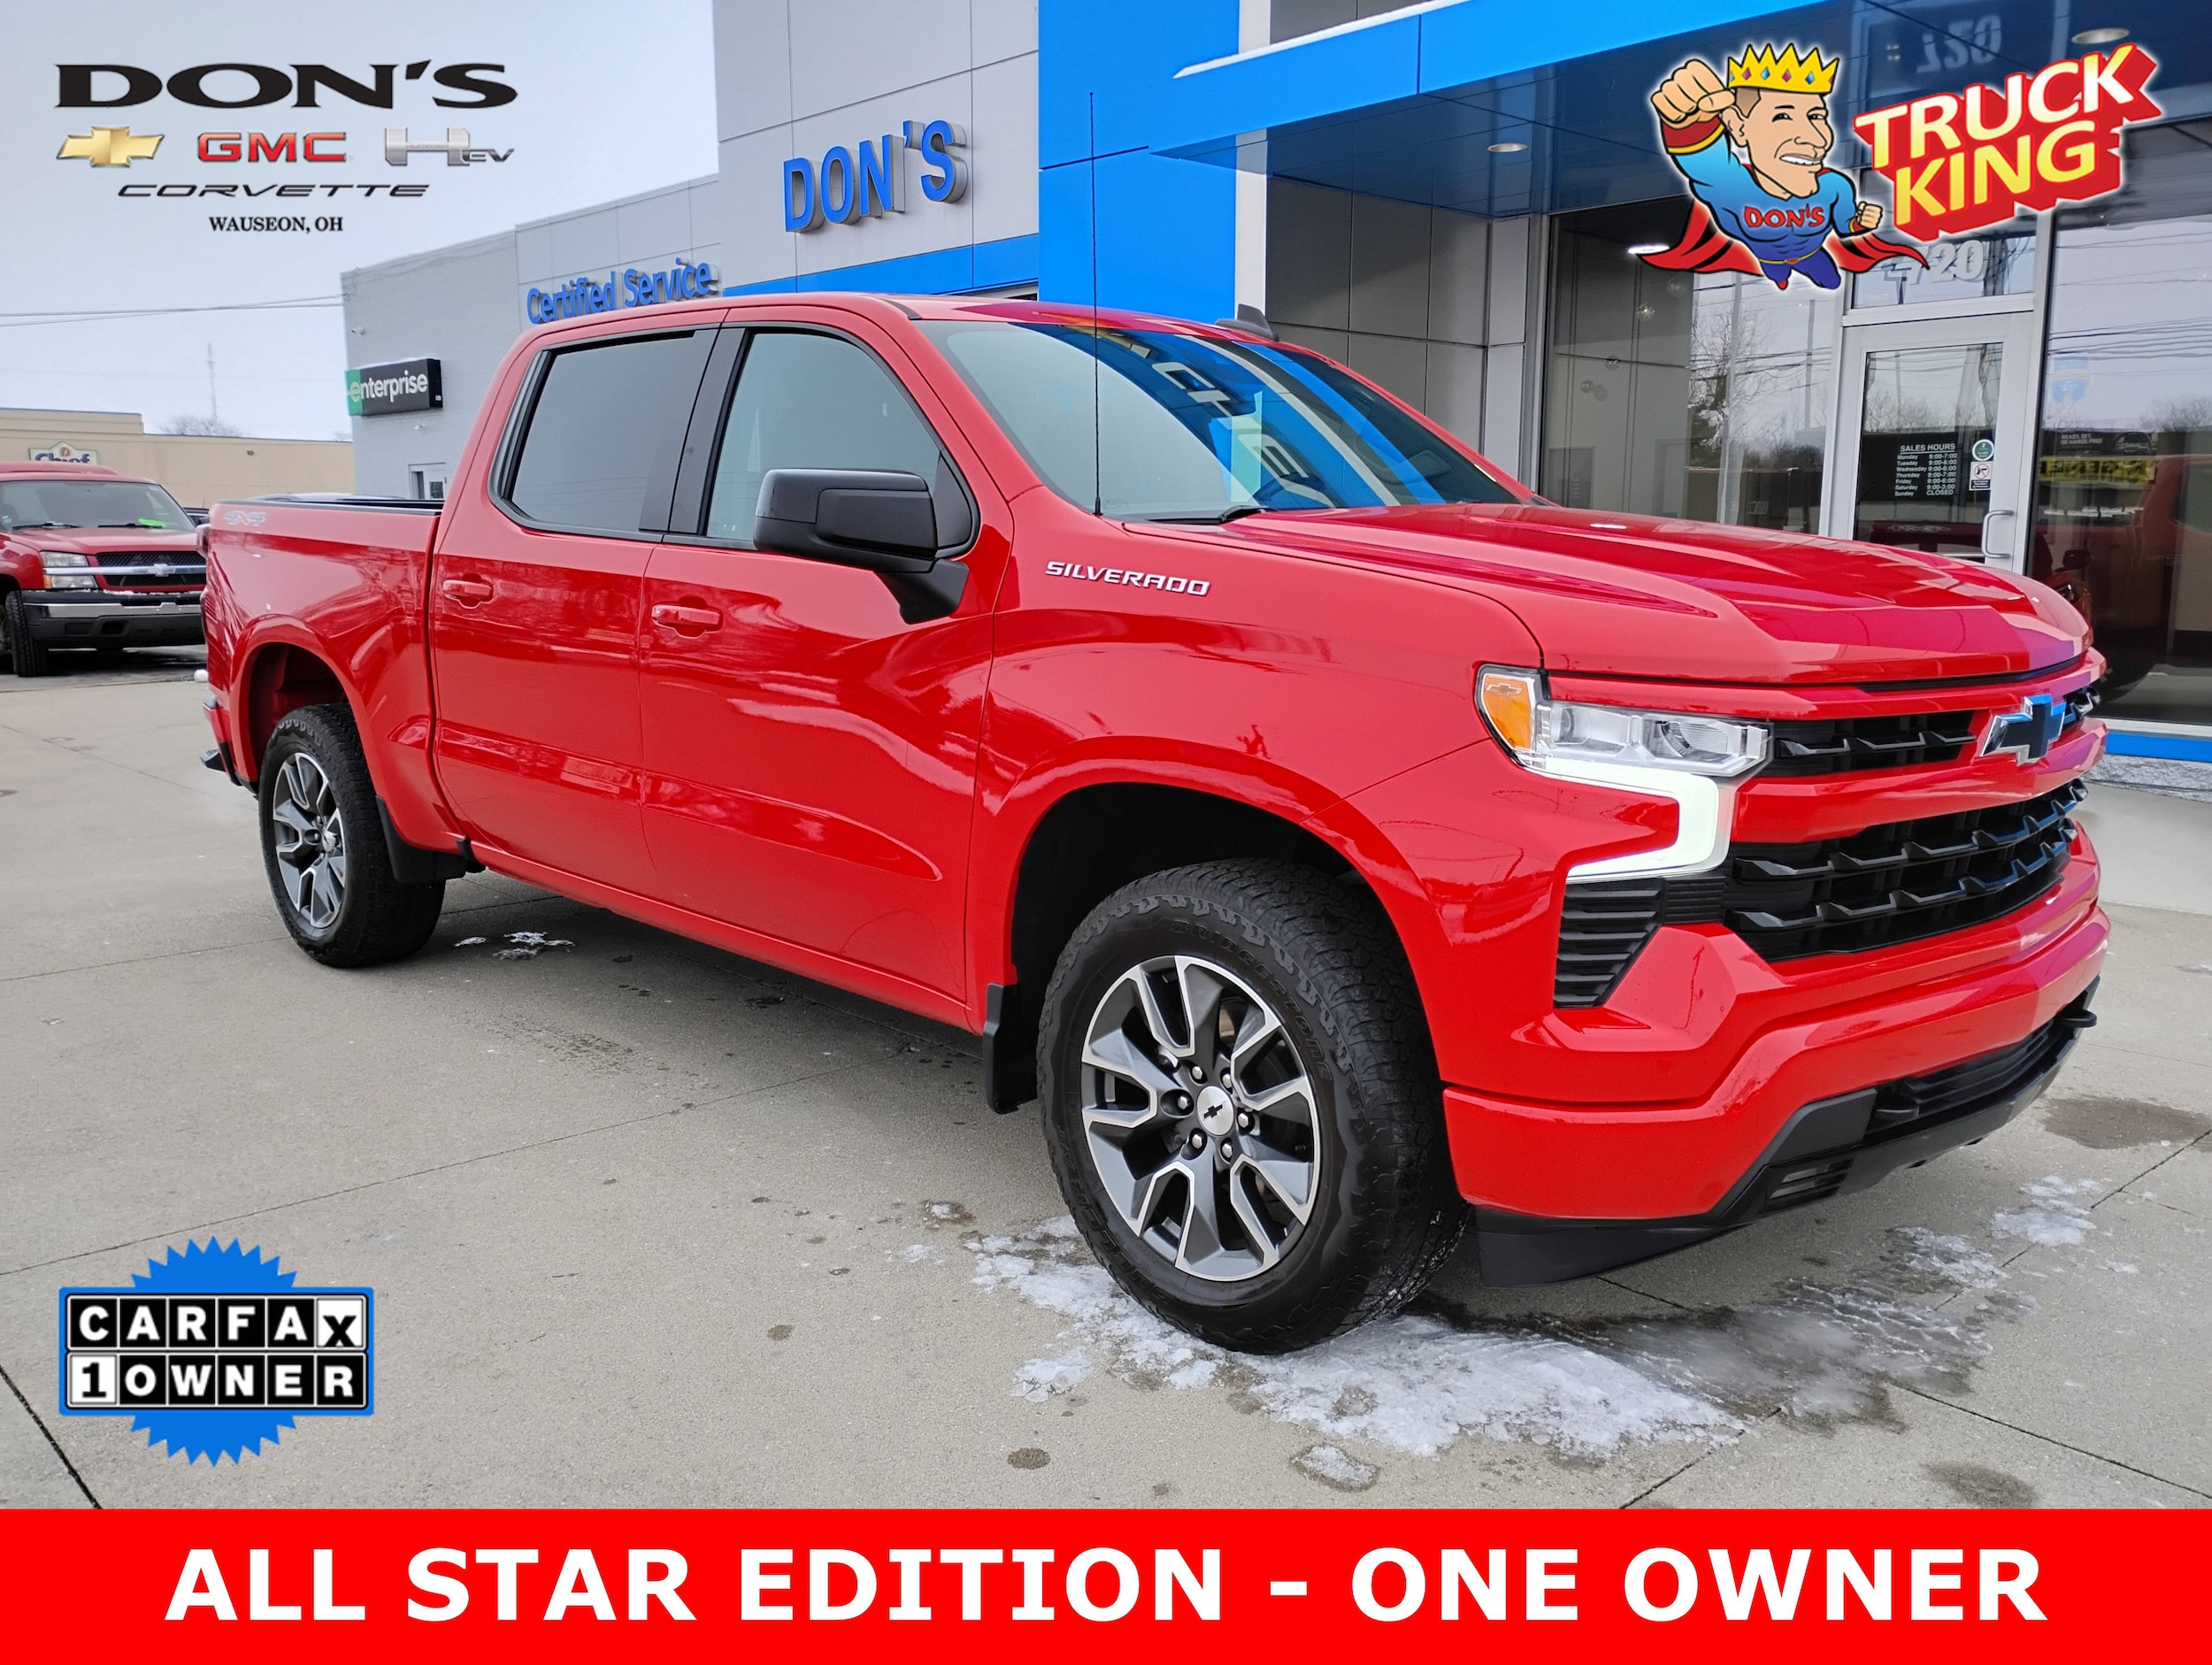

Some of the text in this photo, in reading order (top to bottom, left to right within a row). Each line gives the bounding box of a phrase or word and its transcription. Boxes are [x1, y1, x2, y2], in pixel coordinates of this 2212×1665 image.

[783, 119, 963, 233] DON'S
[526, 257, 712, 325] Certified Service
[348, 370, 428, 403] enterprise
[1045, 560, 1210, 596] SILVERADO
[1170, 918, 1333, 1081] BRIDGESTONE
